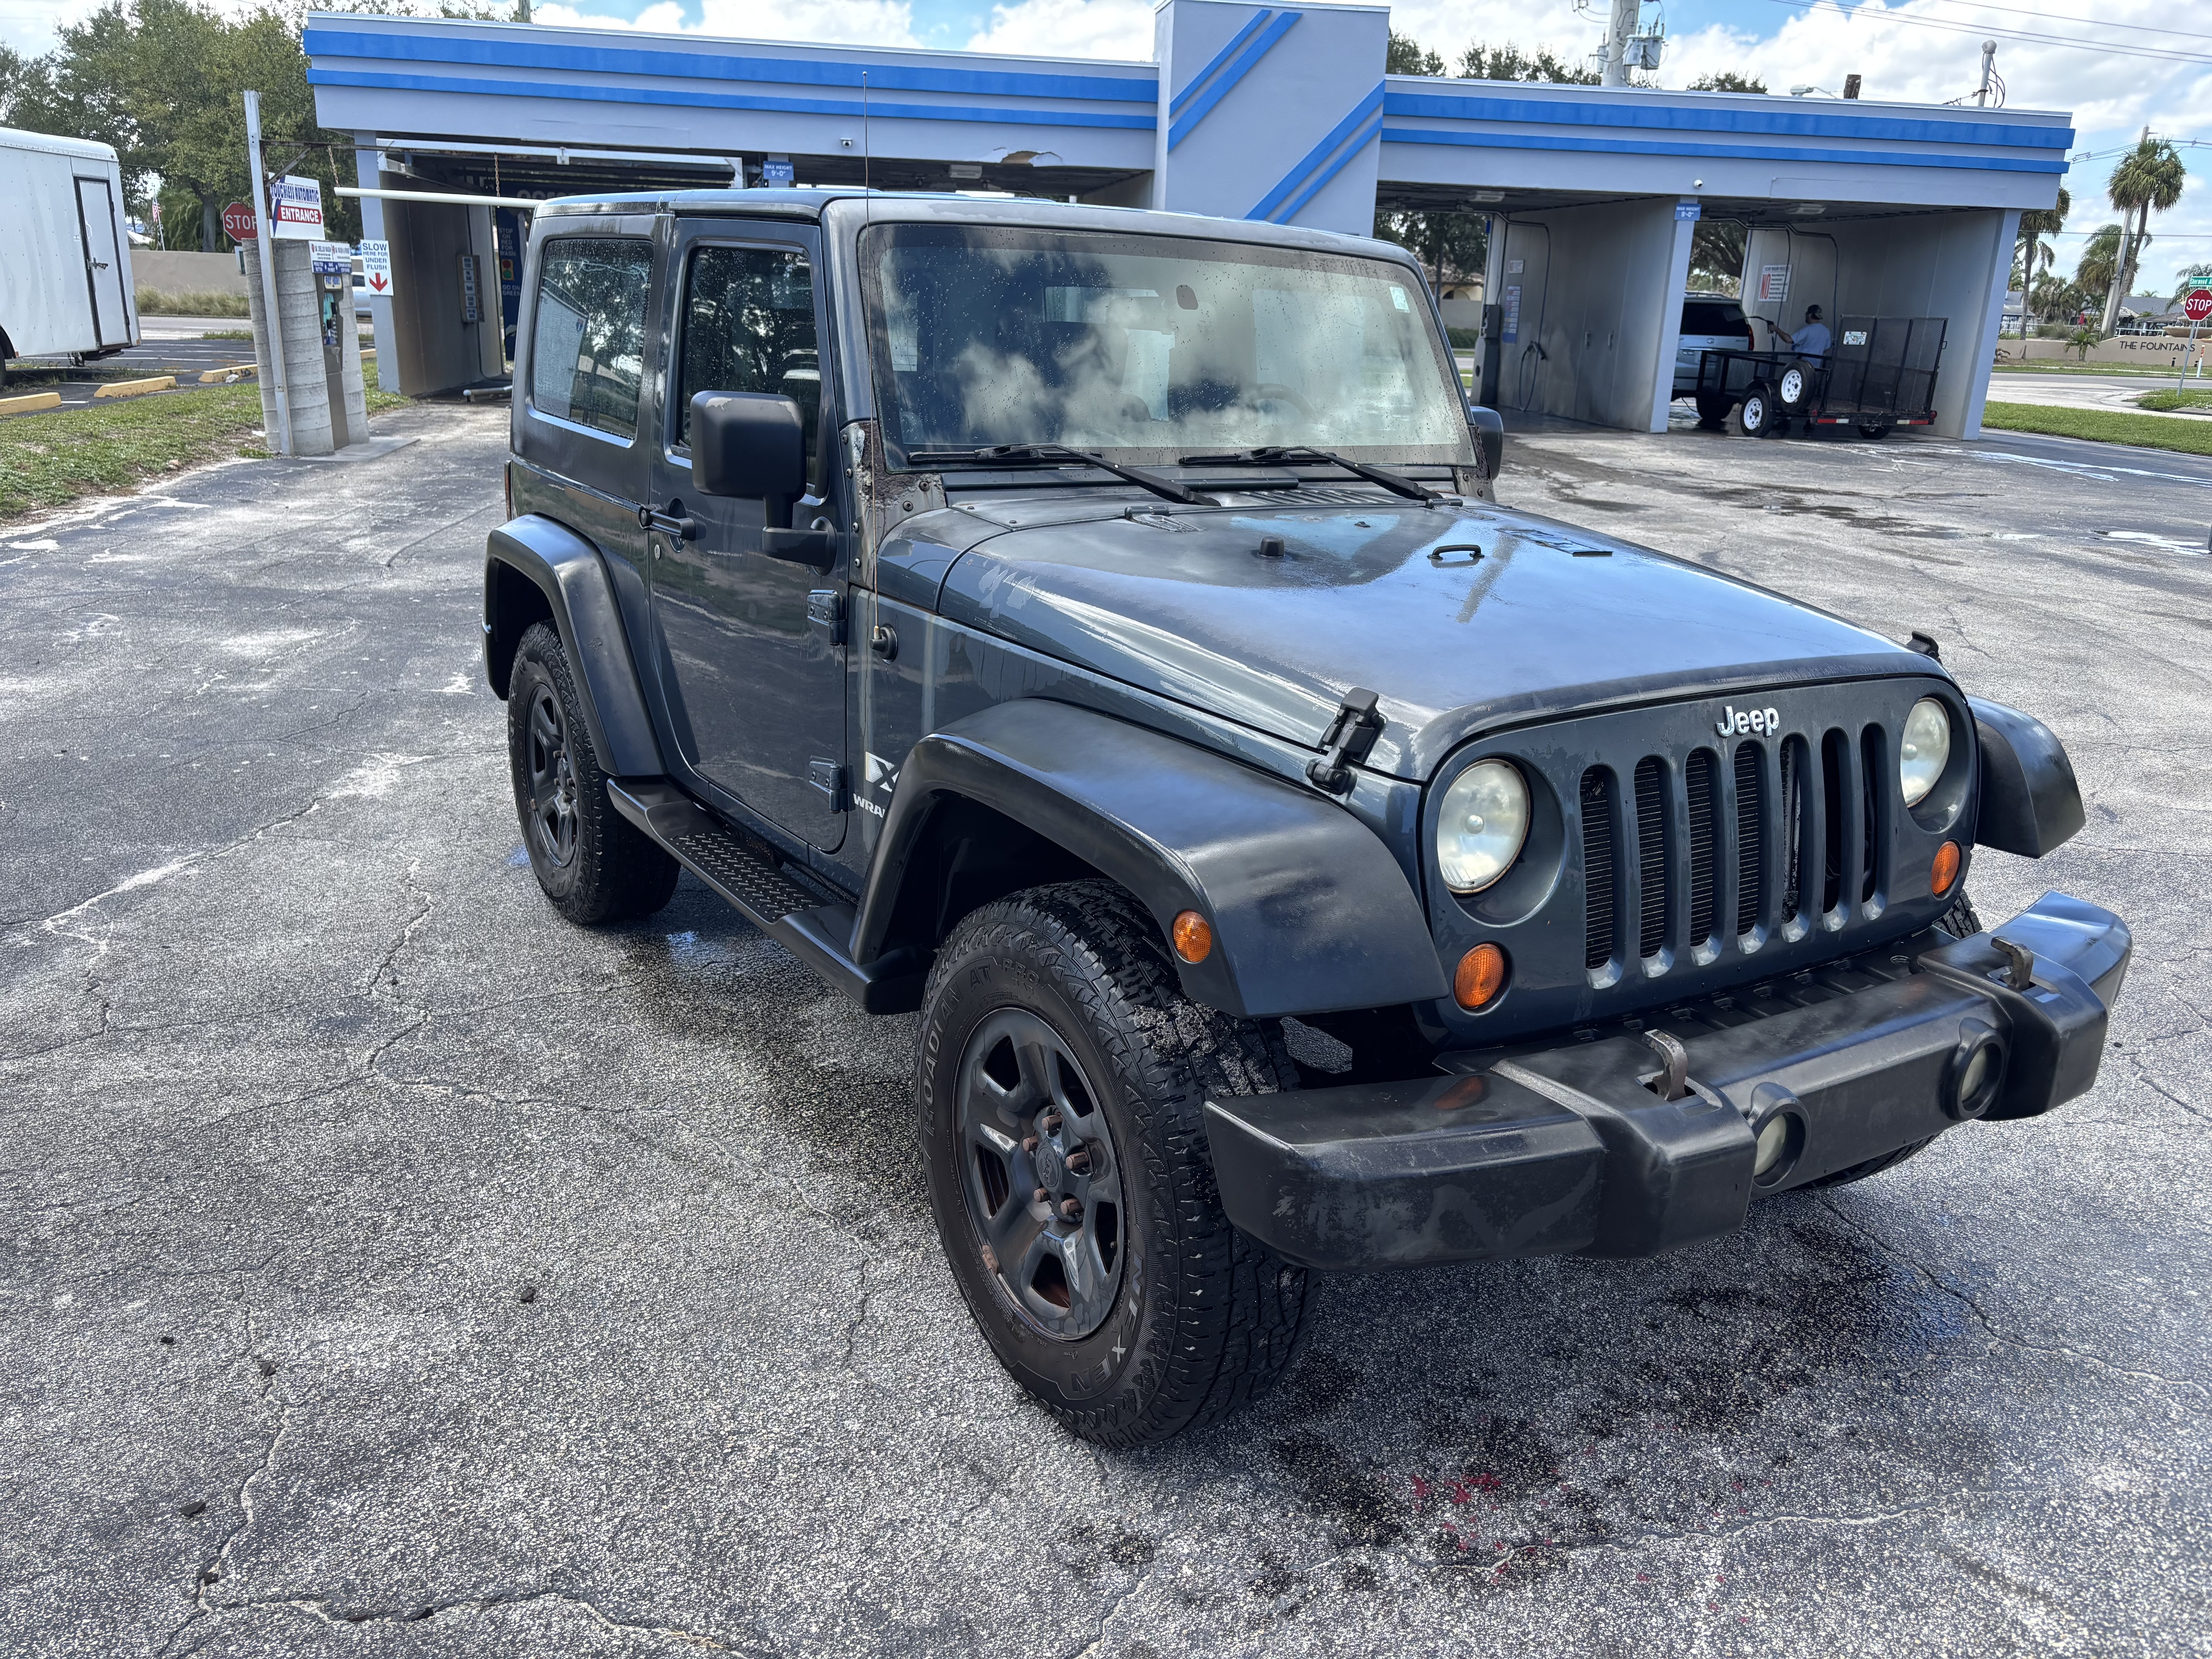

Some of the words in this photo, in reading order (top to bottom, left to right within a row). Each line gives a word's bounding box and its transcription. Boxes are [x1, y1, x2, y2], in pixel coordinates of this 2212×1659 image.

[295, 185, 319, 204] AUTOMATIC
[281, 207, 319, 223] ENTRANCE
[362, 243, 386, 251] SLOW
[2186, 299, 2212, 311] STOP
[2120, 341, 2138, 350] THE
[2140, 342, 2195, 352] FOUNTAINS
[1716, 706, 1779, 738] Jeep
[853, 793, 886, 818] WRA
[923, 982, 963, 1137] ROADIAN
[1002, 957, 1040, 986] PRO
[1070, 1251, 1143, 1394] NEXEN
